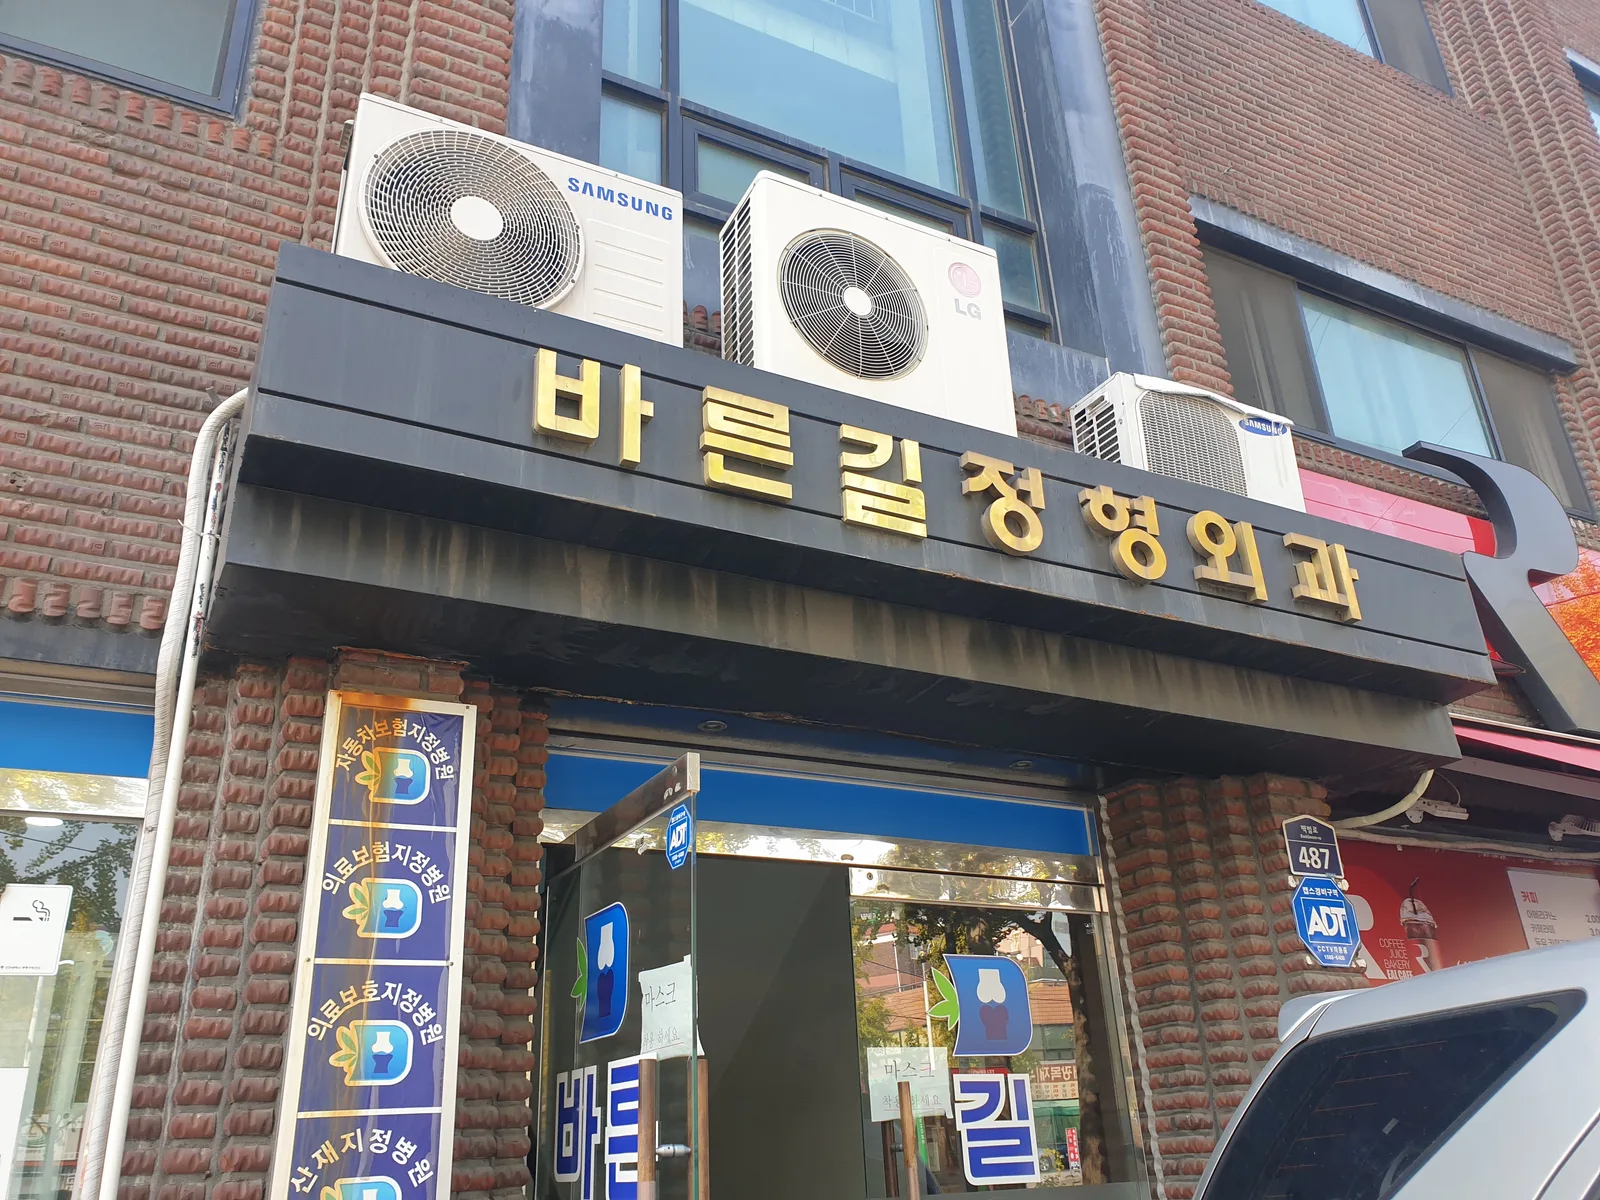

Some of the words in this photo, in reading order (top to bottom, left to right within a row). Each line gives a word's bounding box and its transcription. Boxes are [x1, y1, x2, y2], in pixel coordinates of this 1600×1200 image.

[568, 177, 673, 221] SAMSUNG
[954, 298, 982, 321] LG
[1244, 419, 1284, 436] SAMSUNG
[669, 821, 688, 851] ADT
[1298, 846, 1330, 870] 487
[1520, 890, 1540, 904] 커피
[1308, 906, 1348, 938] ADT
[1379, 938, 1406, 949] COFFEE
[1389, 949, 1409, 959] JUICE
[1383, 959, 1411, 970] BAKERY
[644, 982, 677, 1013] 마스크
[884, 1059, 936, 1083] 마스크
[953, 1073, 1041, 1186] 길
